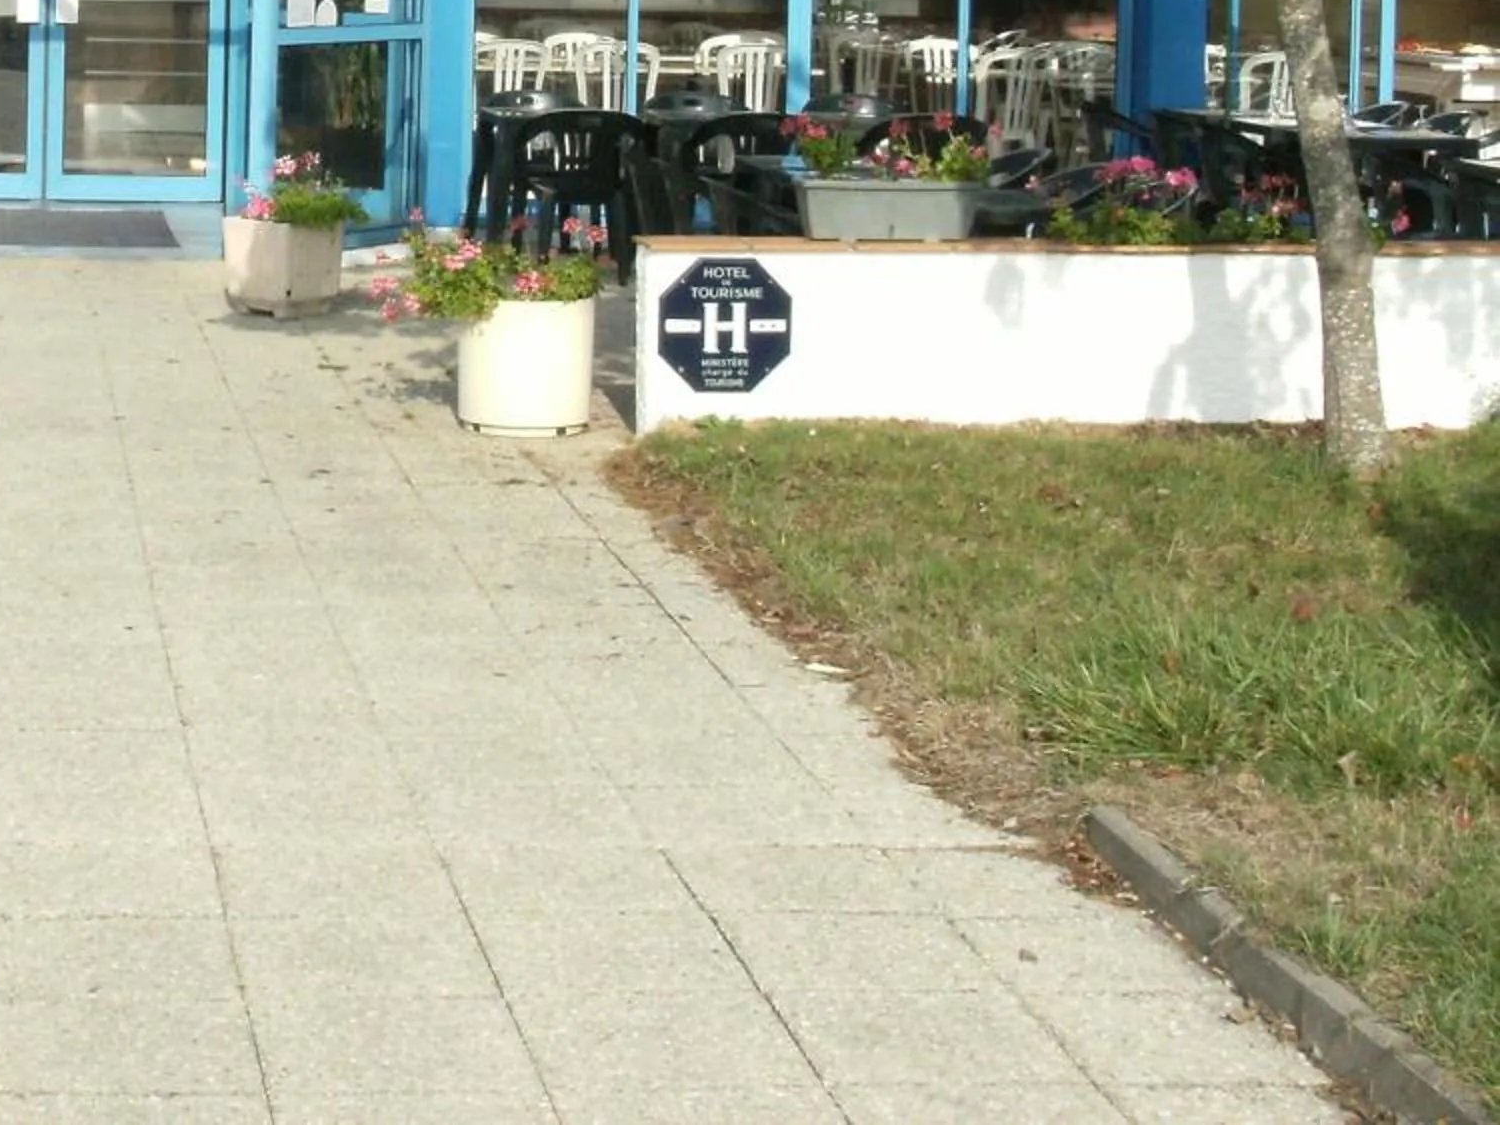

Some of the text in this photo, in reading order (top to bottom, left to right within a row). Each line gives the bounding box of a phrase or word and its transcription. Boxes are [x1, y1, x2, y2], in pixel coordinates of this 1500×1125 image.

[703, 266, 751, 279] HOTEL
[691, 286, 764, 300] TOURISME
[702, 302, 749, 354] H
